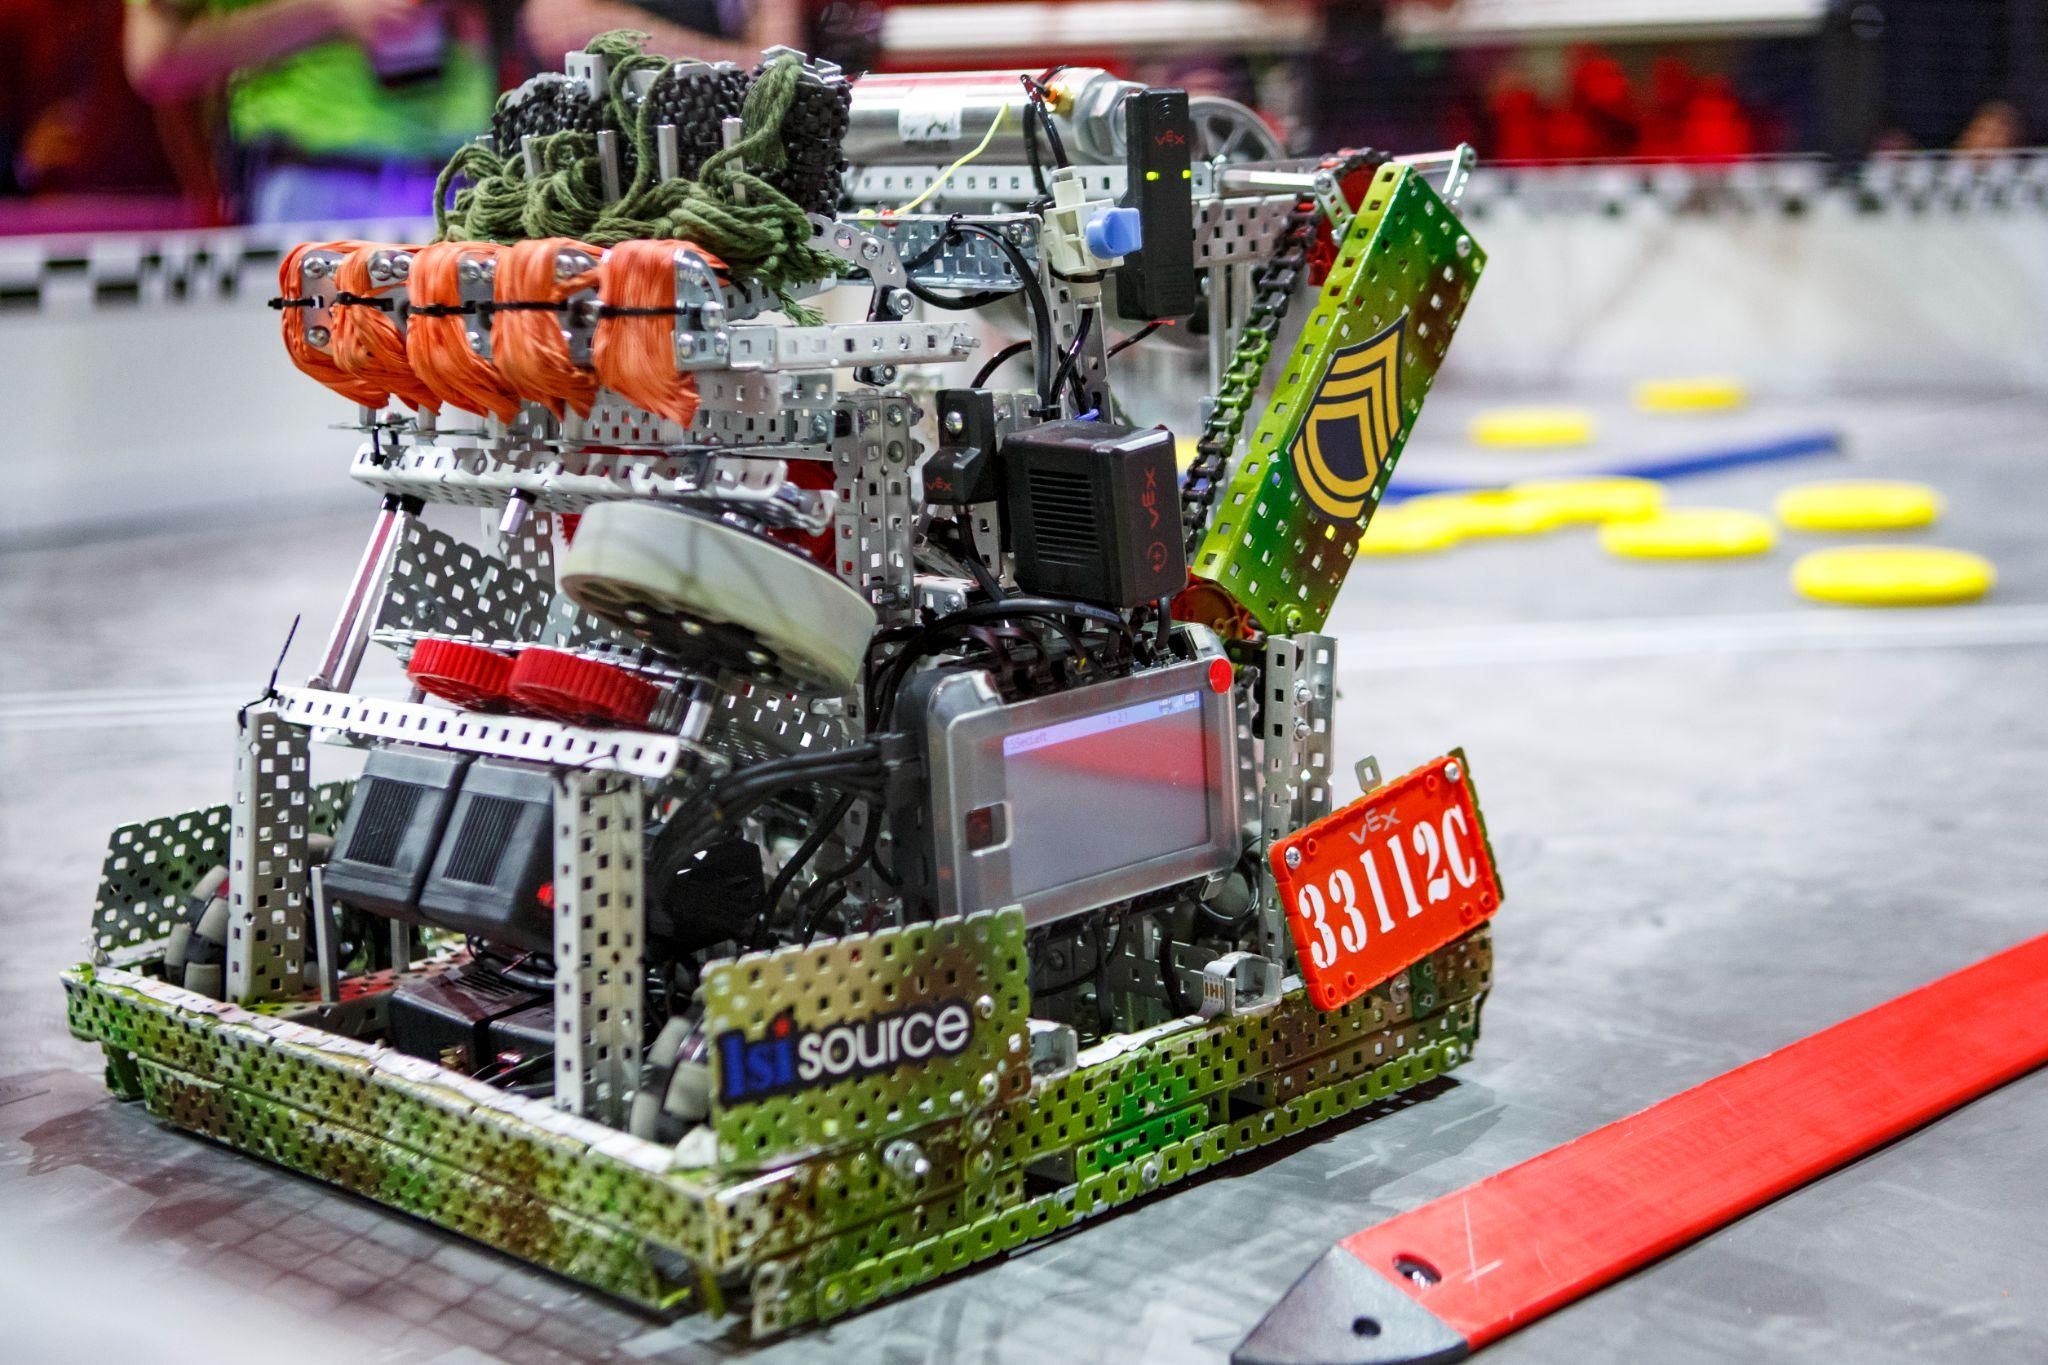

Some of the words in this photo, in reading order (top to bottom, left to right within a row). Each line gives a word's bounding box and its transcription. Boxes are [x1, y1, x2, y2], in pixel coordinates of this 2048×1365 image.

[1142, 467, 1160, 529] VEX
[1349, 807, 1401, 845] VEX
[1299, 804, 1477, 969] 33112C
